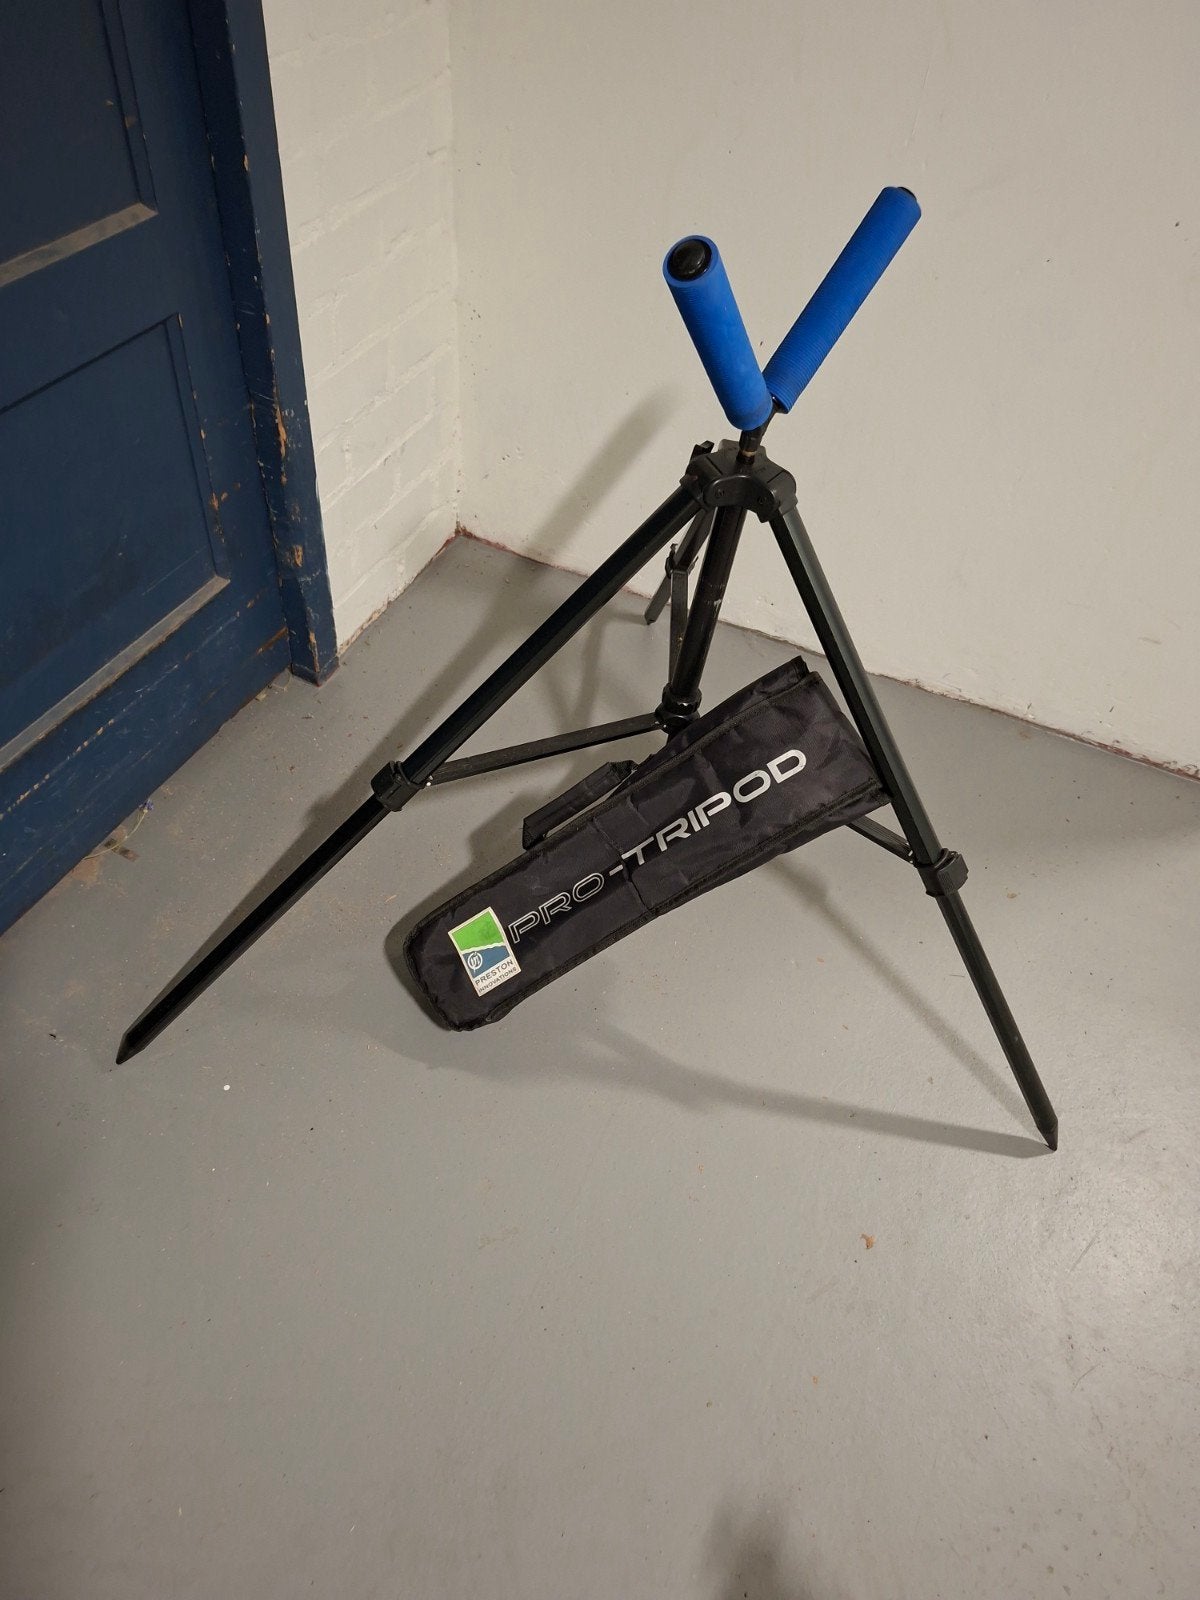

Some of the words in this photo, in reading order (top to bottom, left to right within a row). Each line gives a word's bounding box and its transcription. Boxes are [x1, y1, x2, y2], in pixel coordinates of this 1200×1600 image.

[508, 749, 807, 943] PRO-TRIPOD
[475, 959, 513, 985] PRESTON
[478, 966, 517, 993] INNOVATIONS
